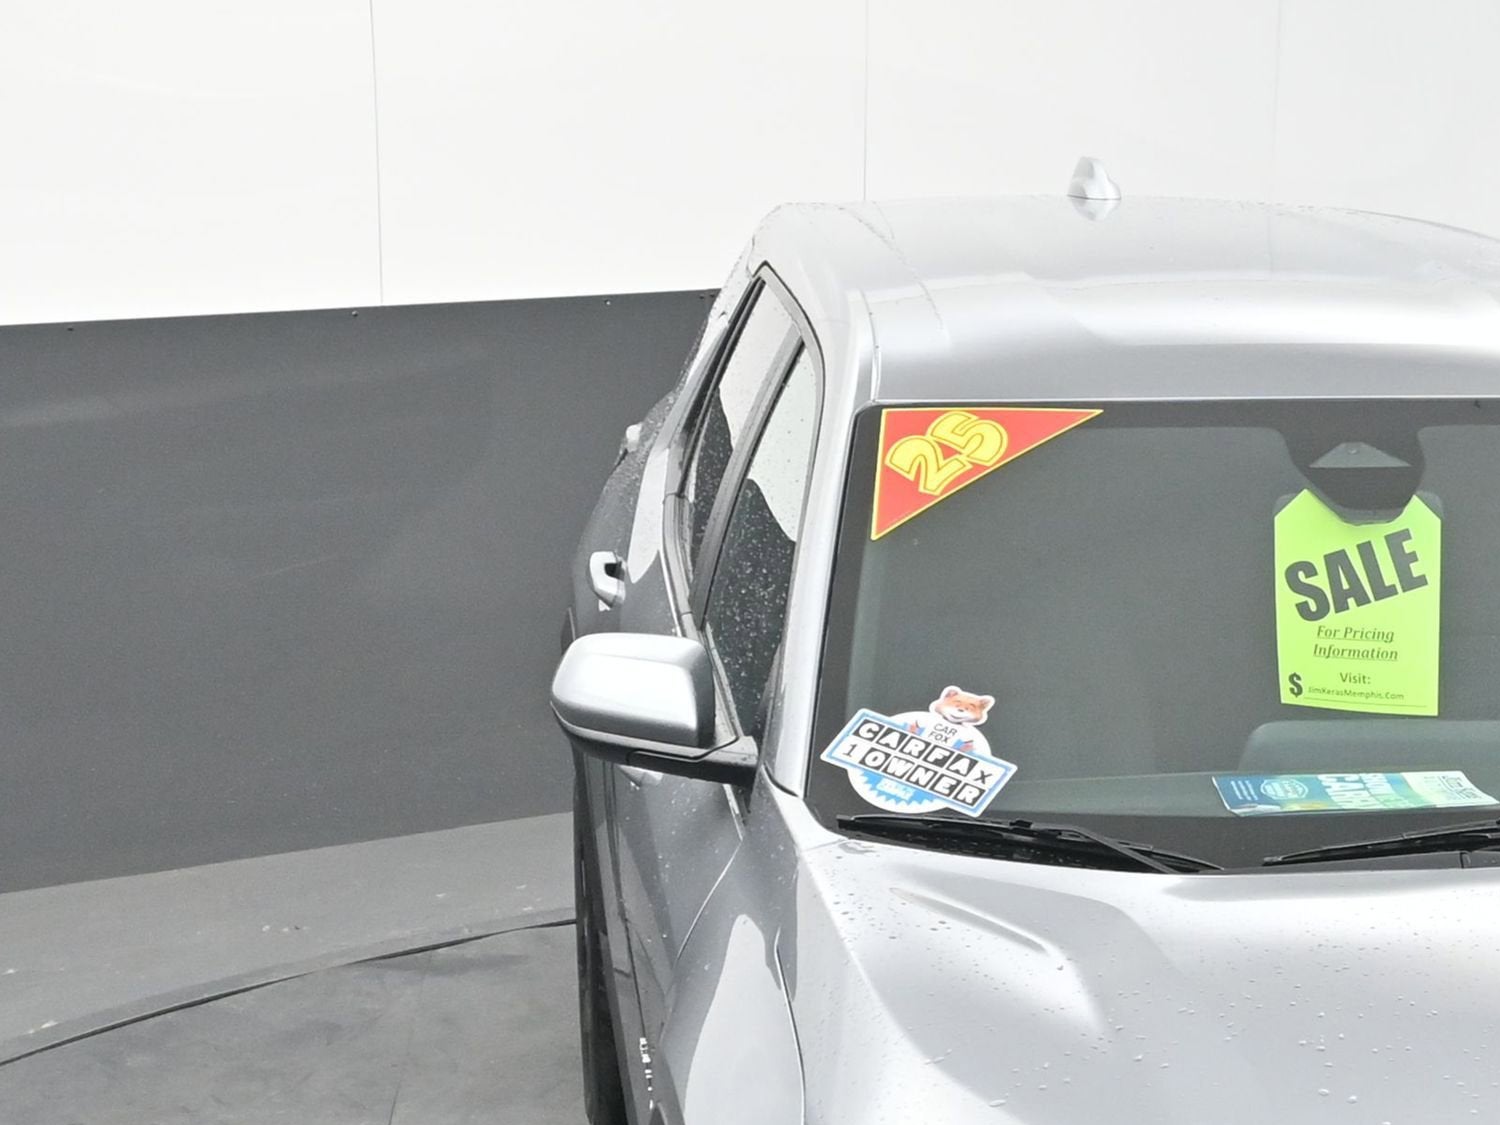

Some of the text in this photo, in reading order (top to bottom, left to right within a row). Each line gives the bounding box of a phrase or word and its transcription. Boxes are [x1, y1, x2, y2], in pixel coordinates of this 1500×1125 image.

[884, 410, 1008, 496] 25
[1284, 528, 1428, 622] SALE
[1316, 625, 1394, 643] For Pricing
[1313, 643, 1398, 660] Information
[1288, 672, 1303, 698] $
[1340, 672, 1371, 685] Visit:
[928, 731, 951, 744] FOX
[933, 723, 958, 736] CAR
[857, 721, 993, 784] CARFAX
[842, 743, 856, 758] 1
[862, 748, 983, 805] OWNER
